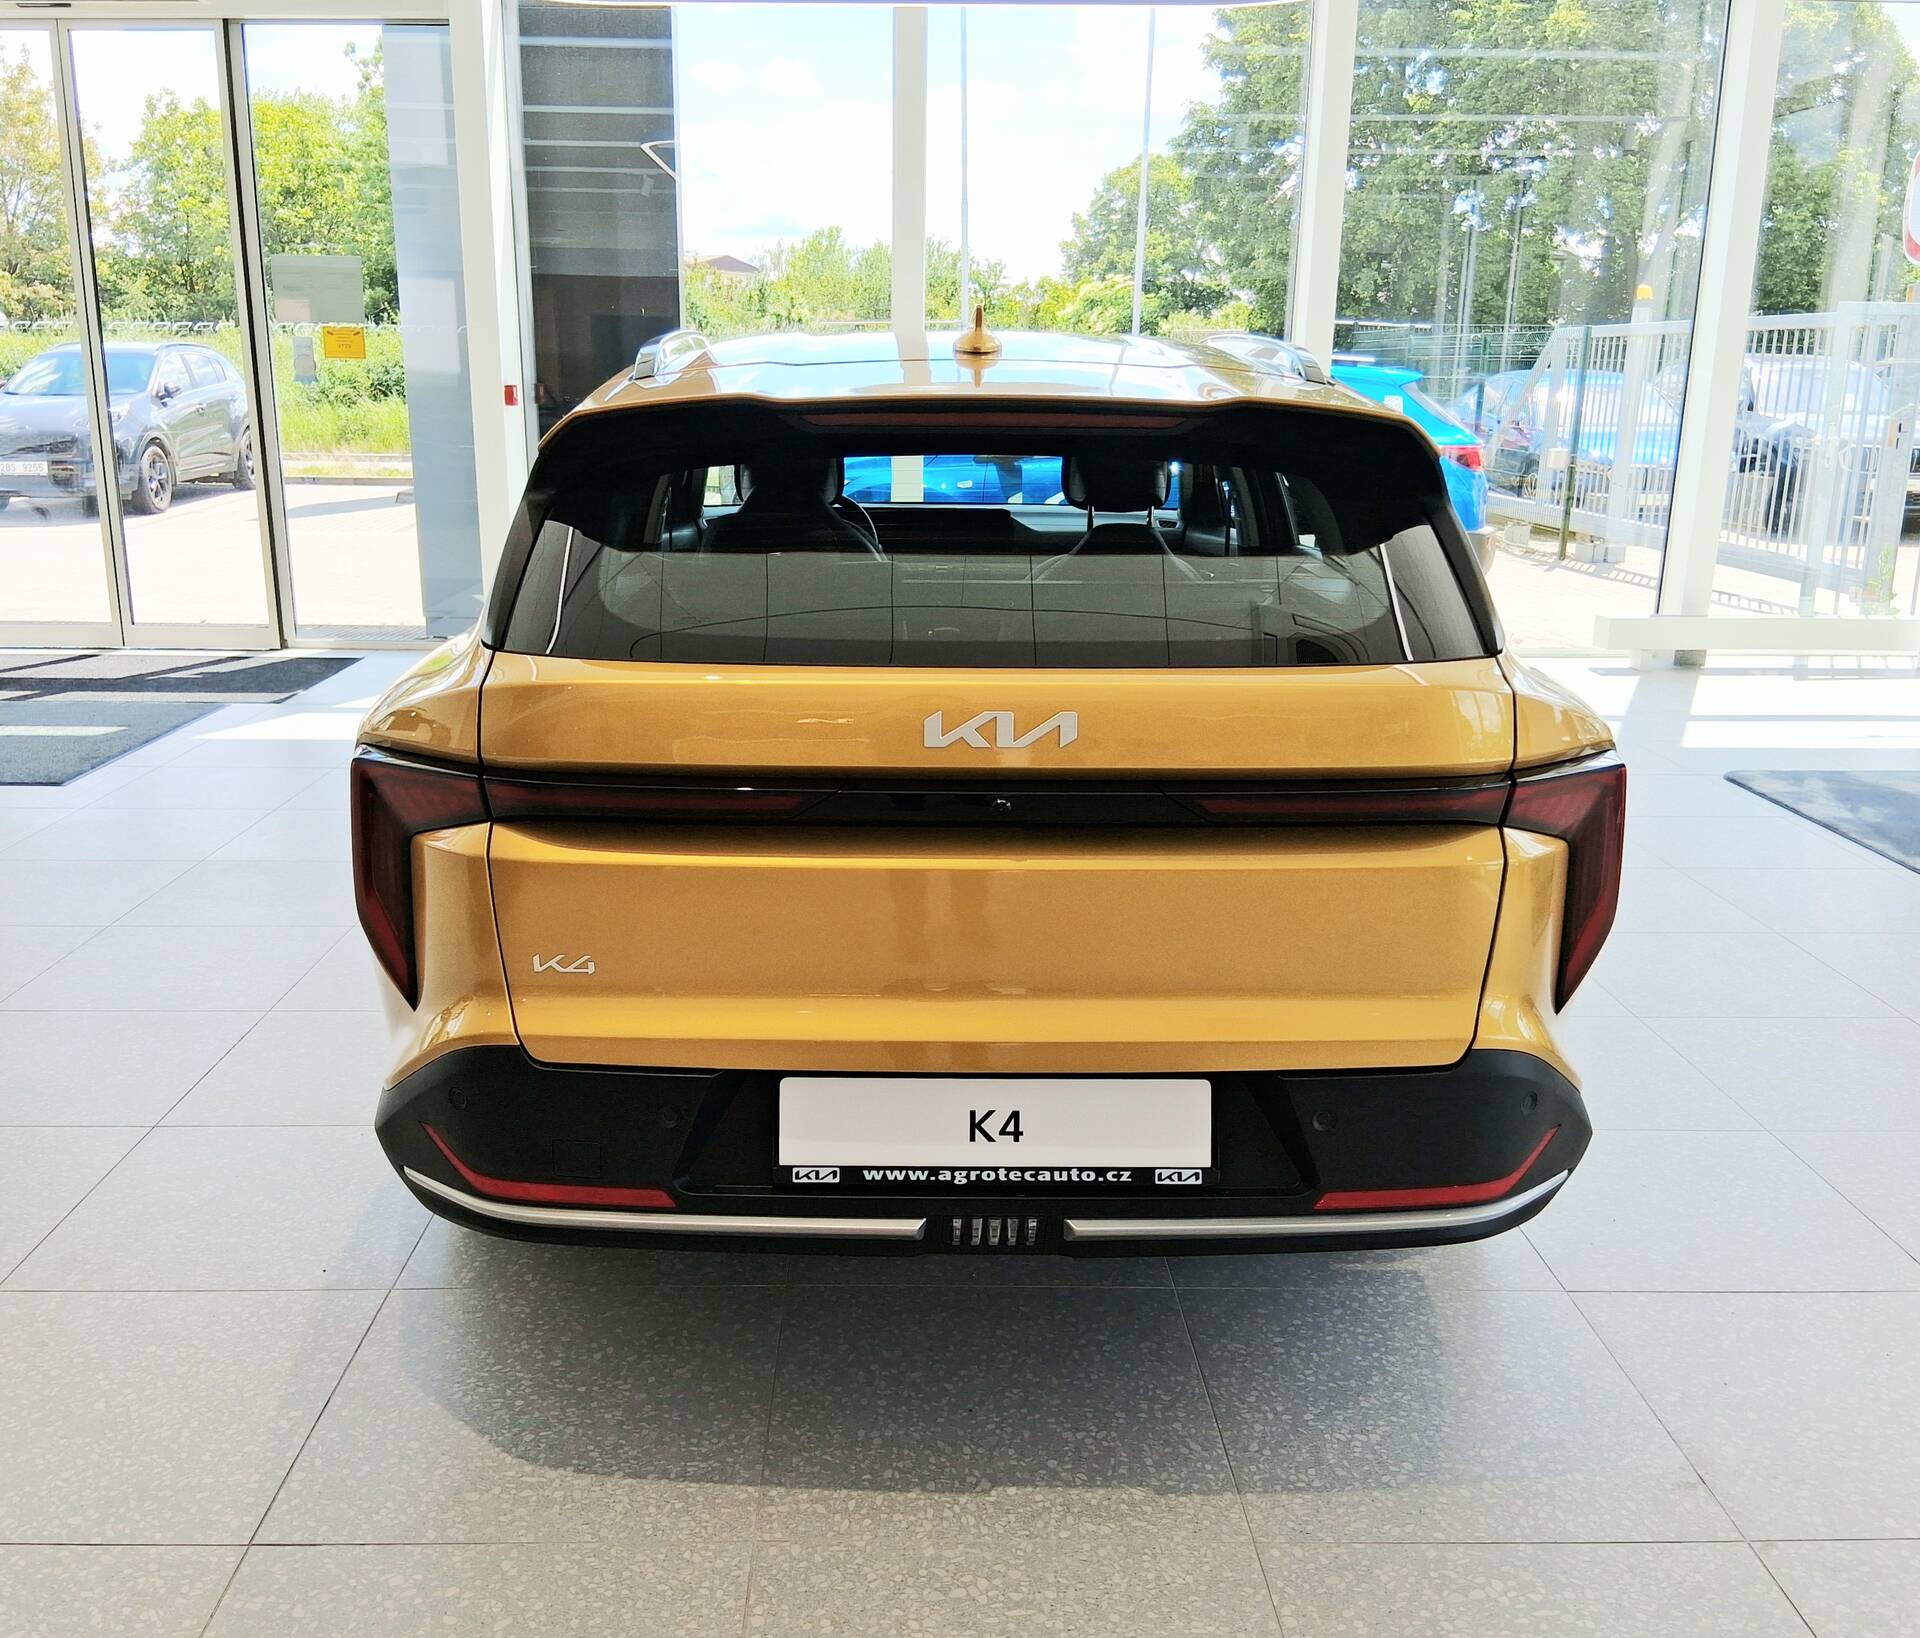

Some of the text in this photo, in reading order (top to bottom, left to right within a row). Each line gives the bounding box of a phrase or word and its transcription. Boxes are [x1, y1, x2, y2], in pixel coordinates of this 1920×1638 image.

[923, 710, 1078, 748] KIA
[532, 953, 595, 975] K4
[969, 1109, 1024, 1143] K4
[862, 1167, 1132, 1185] www.agrotecauto.cz
